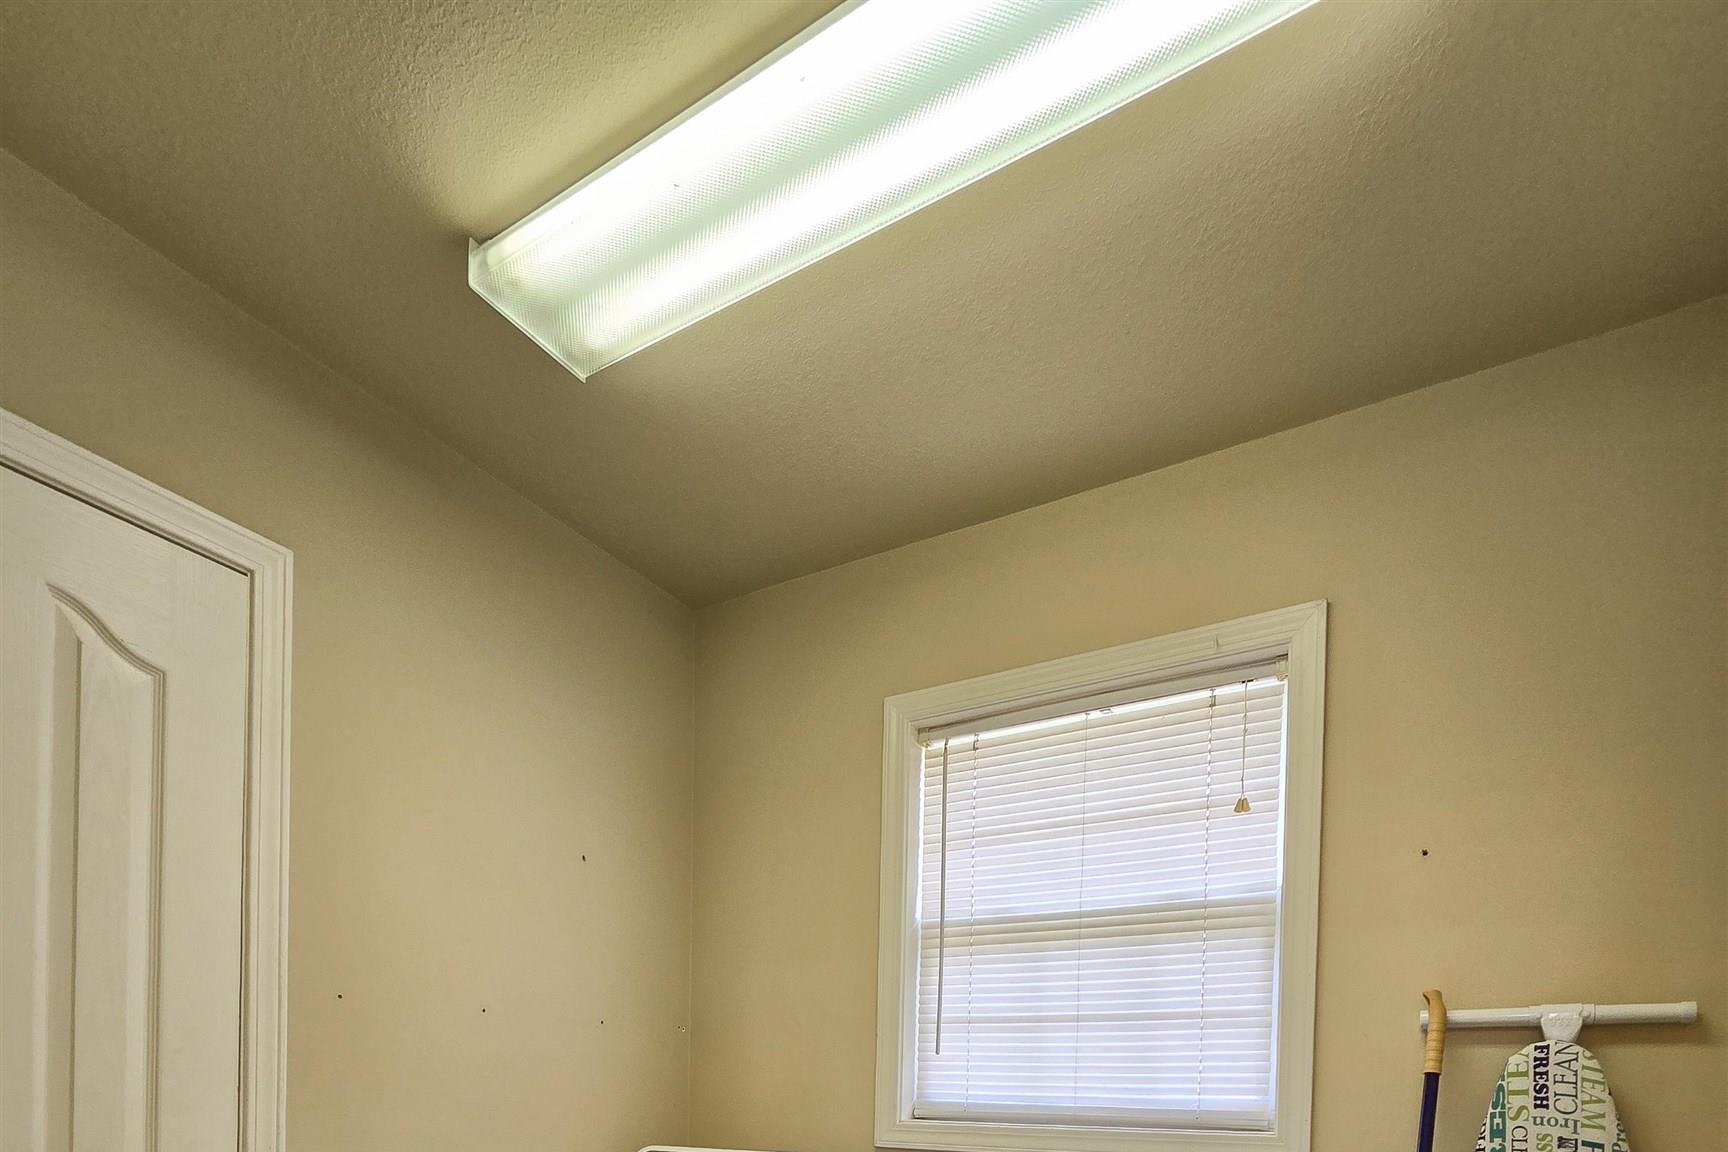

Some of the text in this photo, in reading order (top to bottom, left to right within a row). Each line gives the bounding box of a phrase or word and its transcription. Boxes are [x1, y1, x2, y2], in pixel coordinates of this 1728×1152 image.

[1533, 1044, 1550, 1110] FRESH
[1553, 1040, 1579, 1115] CLEAN
[1531, 1116, 1580, 1135] Iron
